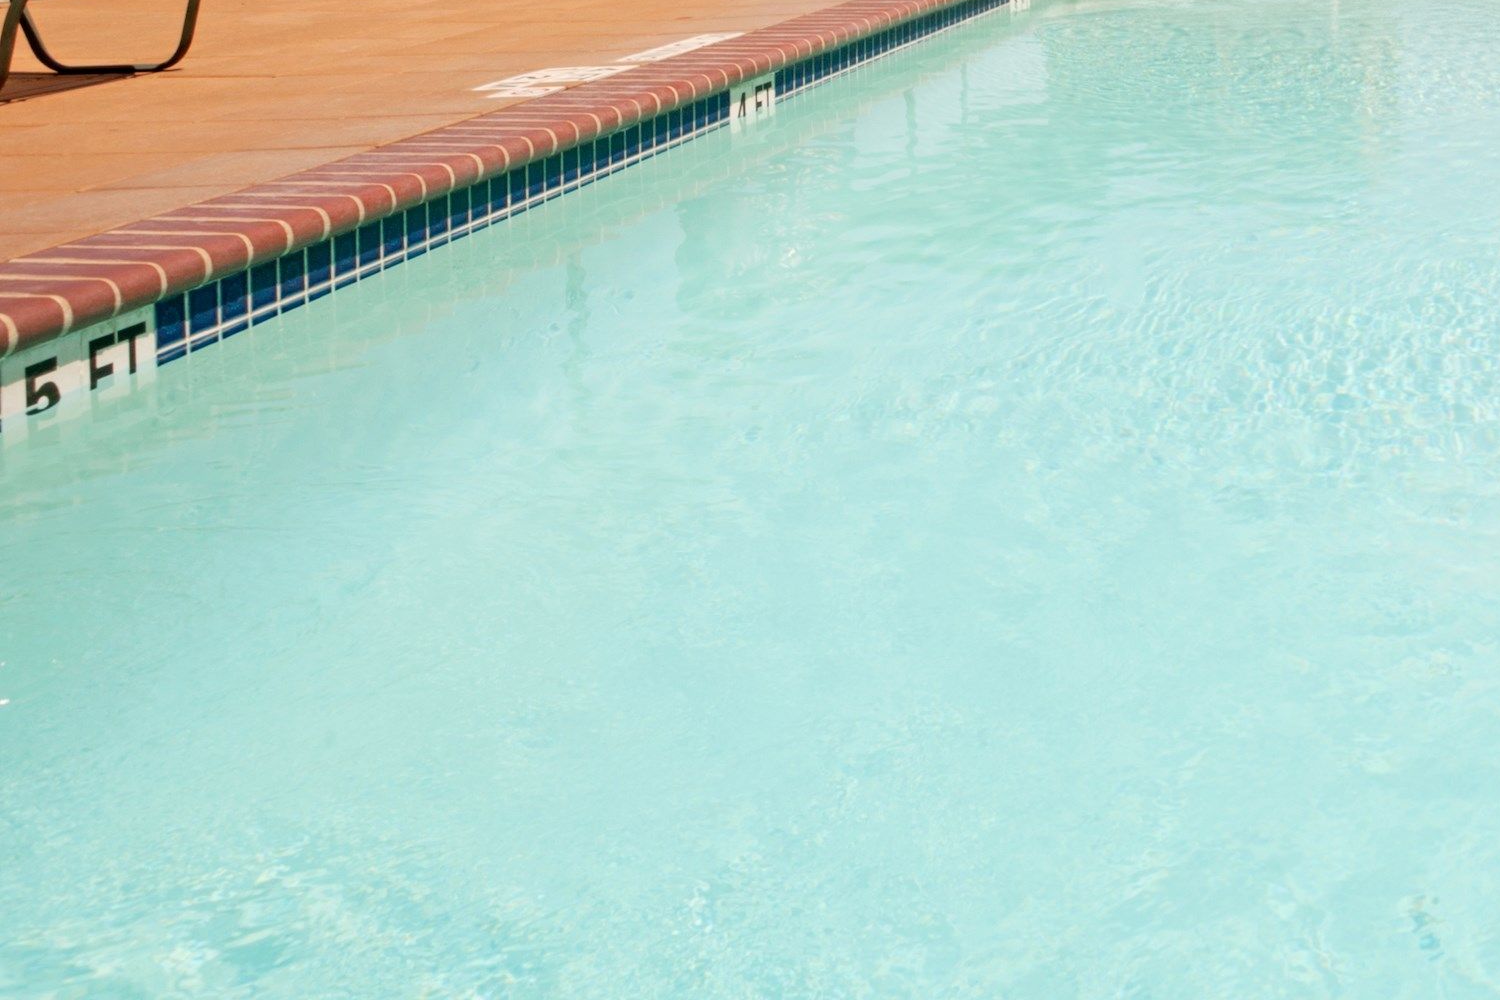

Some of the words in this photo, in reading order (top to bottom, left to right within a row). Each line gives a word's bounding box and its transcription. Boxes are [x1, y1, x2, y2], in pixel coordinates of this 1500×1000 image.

[755, 81, 772, 112] FT
[25, 356, 61, 416] 5
[89, 321, 146, 391] FT
